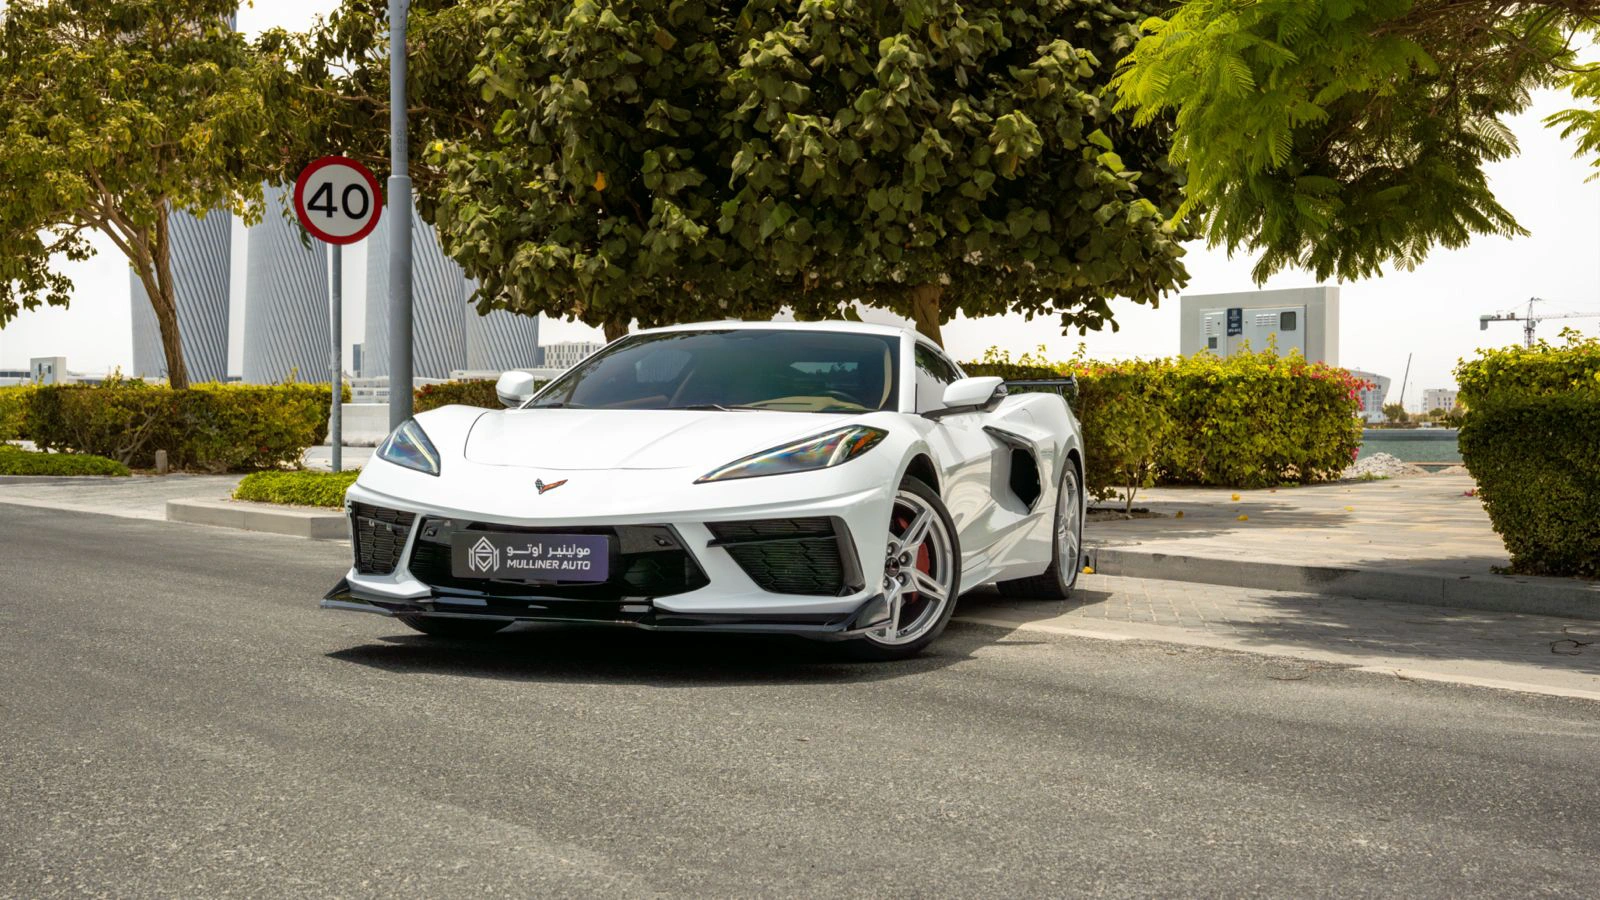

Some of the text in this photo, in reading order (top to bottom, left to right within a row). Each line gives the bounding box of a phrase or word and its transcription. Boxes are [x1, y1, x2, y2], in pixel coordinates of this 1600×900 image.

[307, 182, 369, 219] 40
[547, 543, 591, 558] مولينير
[506, 559, 591, 570] MULLINER AUTO
